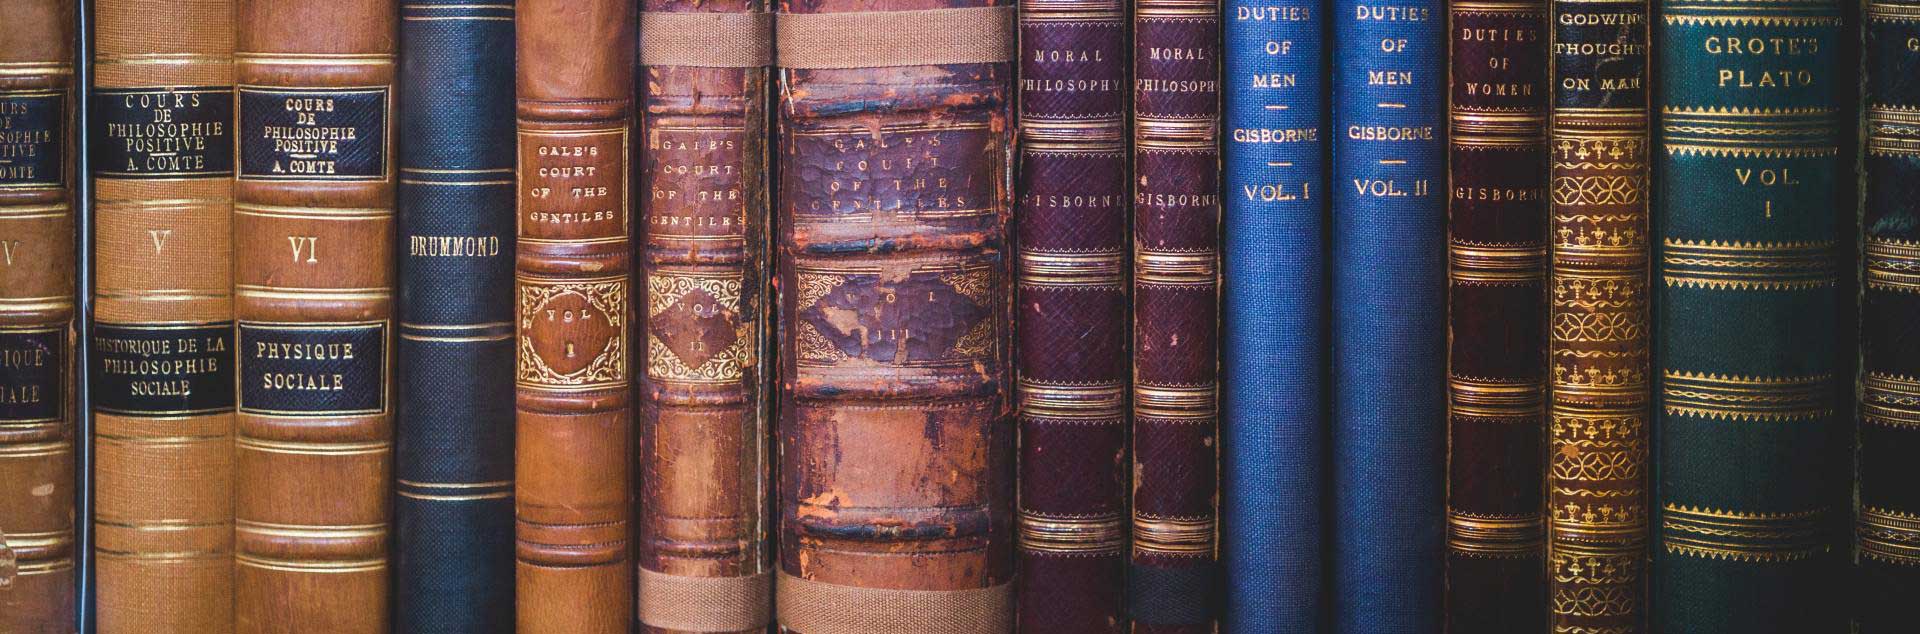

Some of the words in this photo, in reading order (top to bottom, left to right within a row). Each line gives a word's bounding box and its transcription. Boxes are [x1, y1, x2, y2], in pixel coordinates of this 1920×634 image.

[1238, 6, 1310, 21] DUTIES
[1356, 5, 1429, 21] DUTIES
[1463, 28, 1536, 42] DUTIES
[1266, 41, 1292, 55] OF
[1381, 38, 1408, 53] OF
[1705, 36, 1819, 56] GROTE'S
[1034, 50, 1103, 63] MORAL
[1150, 47, 1205, 60] MORAL
[1489, 57, 1510, 71] OF
[1253, 74, 1295, 88] MEN
[1369, 71, 1412, 85] MEN
[1562, 78, 1590, 91] ON
[1600, 78, 1640, 90] MAN
[1719, 69, 1812, 88] PLATO
[1021, 79, 1120, 92] PHILOSOPHY
[1137, 79, 1216, 93] PHILOSOPH
[1466, 82, 1532, 96] WOMEN
[126, 94, 199, 108] COURS
[285, 99, 334, 112] COURS
[0, 102, 28, 115] URS
[154, 109, 172, 123] DE
[297, 113, 316, 126] DE
[108, 122, 223, 138] PHILOSOPHIE
[263, 126, 356, 140] PHILOSOPHIE
[1233, 128, 1318, 143] GISBORNE
[1349, 126, 1433, 141] GISBORNE
[0, 131, 51, 144] SOPHIE
[0, 144, 36, 157] TIVE
[126, 137, 205, 153] POSITIVE
[274, 139, 337, 153] POSITIVE
[538, 146, 598, 157] GALE'S
[127, 158, 139, 171] A.
[147, 155, 204, 171] COMTE
[272, 160, 286, 174] A.
[290, 161, 335, 174] COMTE
[663, 165, 733, 175] COURT
[0, 166, 35, 179] OMTE
[539, 166, 596, 178] COURT
[830, 181, 862, 191] OF
[893, 177, 948, 192] THE
[1244, 184, 1296, 201] VOL.
[1303, 182, 1310, 199] I
[1354, 179, 1408, 197] VOL.
[1415, 179, 1428, 196] II
[531, 188, 551, 198] OF
[572, 187, 608, 198] THE
[656, 190, 677, 200] OF
[699, 190, 738, 201] THE
[1765, 200, 1772, 218] I
[530, 210, 614, 224] GENTILES
[650, 216, 744, 226] GENTILES
[150, 230, 171, 254] V
[410, 235, 499, 257] DRUMMOND
[288, 236, 318, 263] VI
[678, 302, 719, 314] VOL
[546, 309, 592, 323] VOL
[95, 336, 170, 357] HISTORIQUE
[178, 339, 197, 353] DE
[207, 337, 225, 352] LA
[256, 341, 354, 360] PHYSIQUE
[565, 342, 575, 357] I
[690, 341, 703, 350] II
[4, 349, 44, 369] IQUE
[104, 358, 217, 375] PHILOSOPHIE
[131, 380, 191, 396] SOCIALE
[263, 373, 343, 390] SOCIALE
[0, 385, 40, 403] IALE
